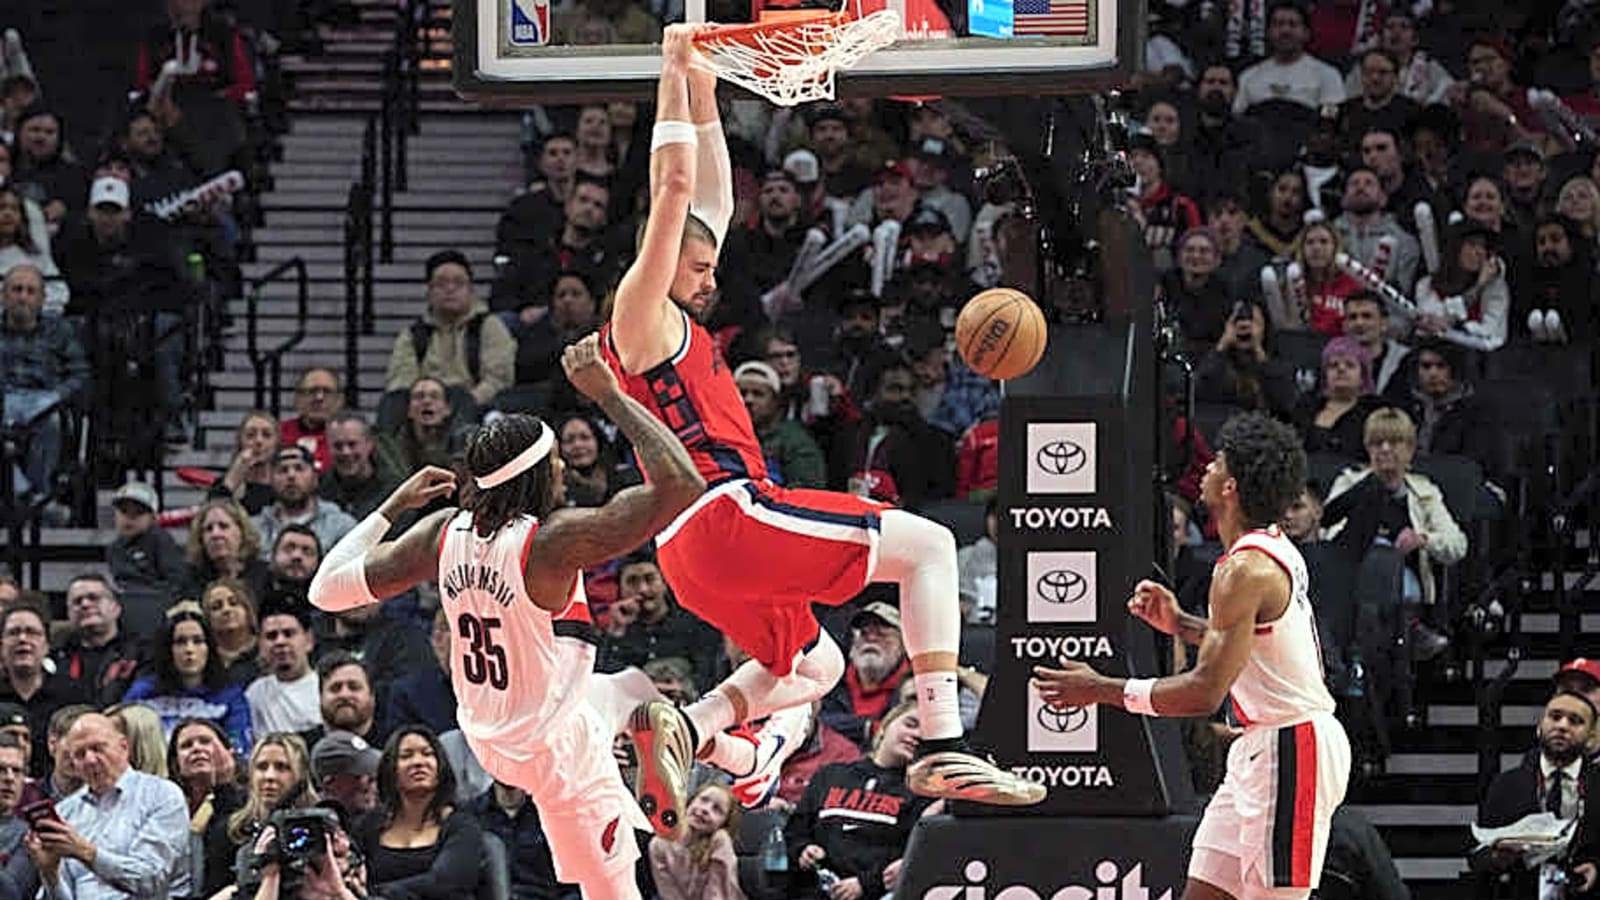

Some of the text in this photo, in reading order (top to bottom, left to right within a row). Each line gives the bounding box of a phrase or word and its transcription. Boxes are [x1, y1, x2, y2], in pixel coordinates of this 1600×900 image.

[514, 24, 535, 40] NBA
[1010, 508, 1112, 529] TOYOTA
[458, 612, 509, 691] 35
[1011, 636, 1114, 658] TOYOTA
[823, 785, 905, 816] BLAZERS
